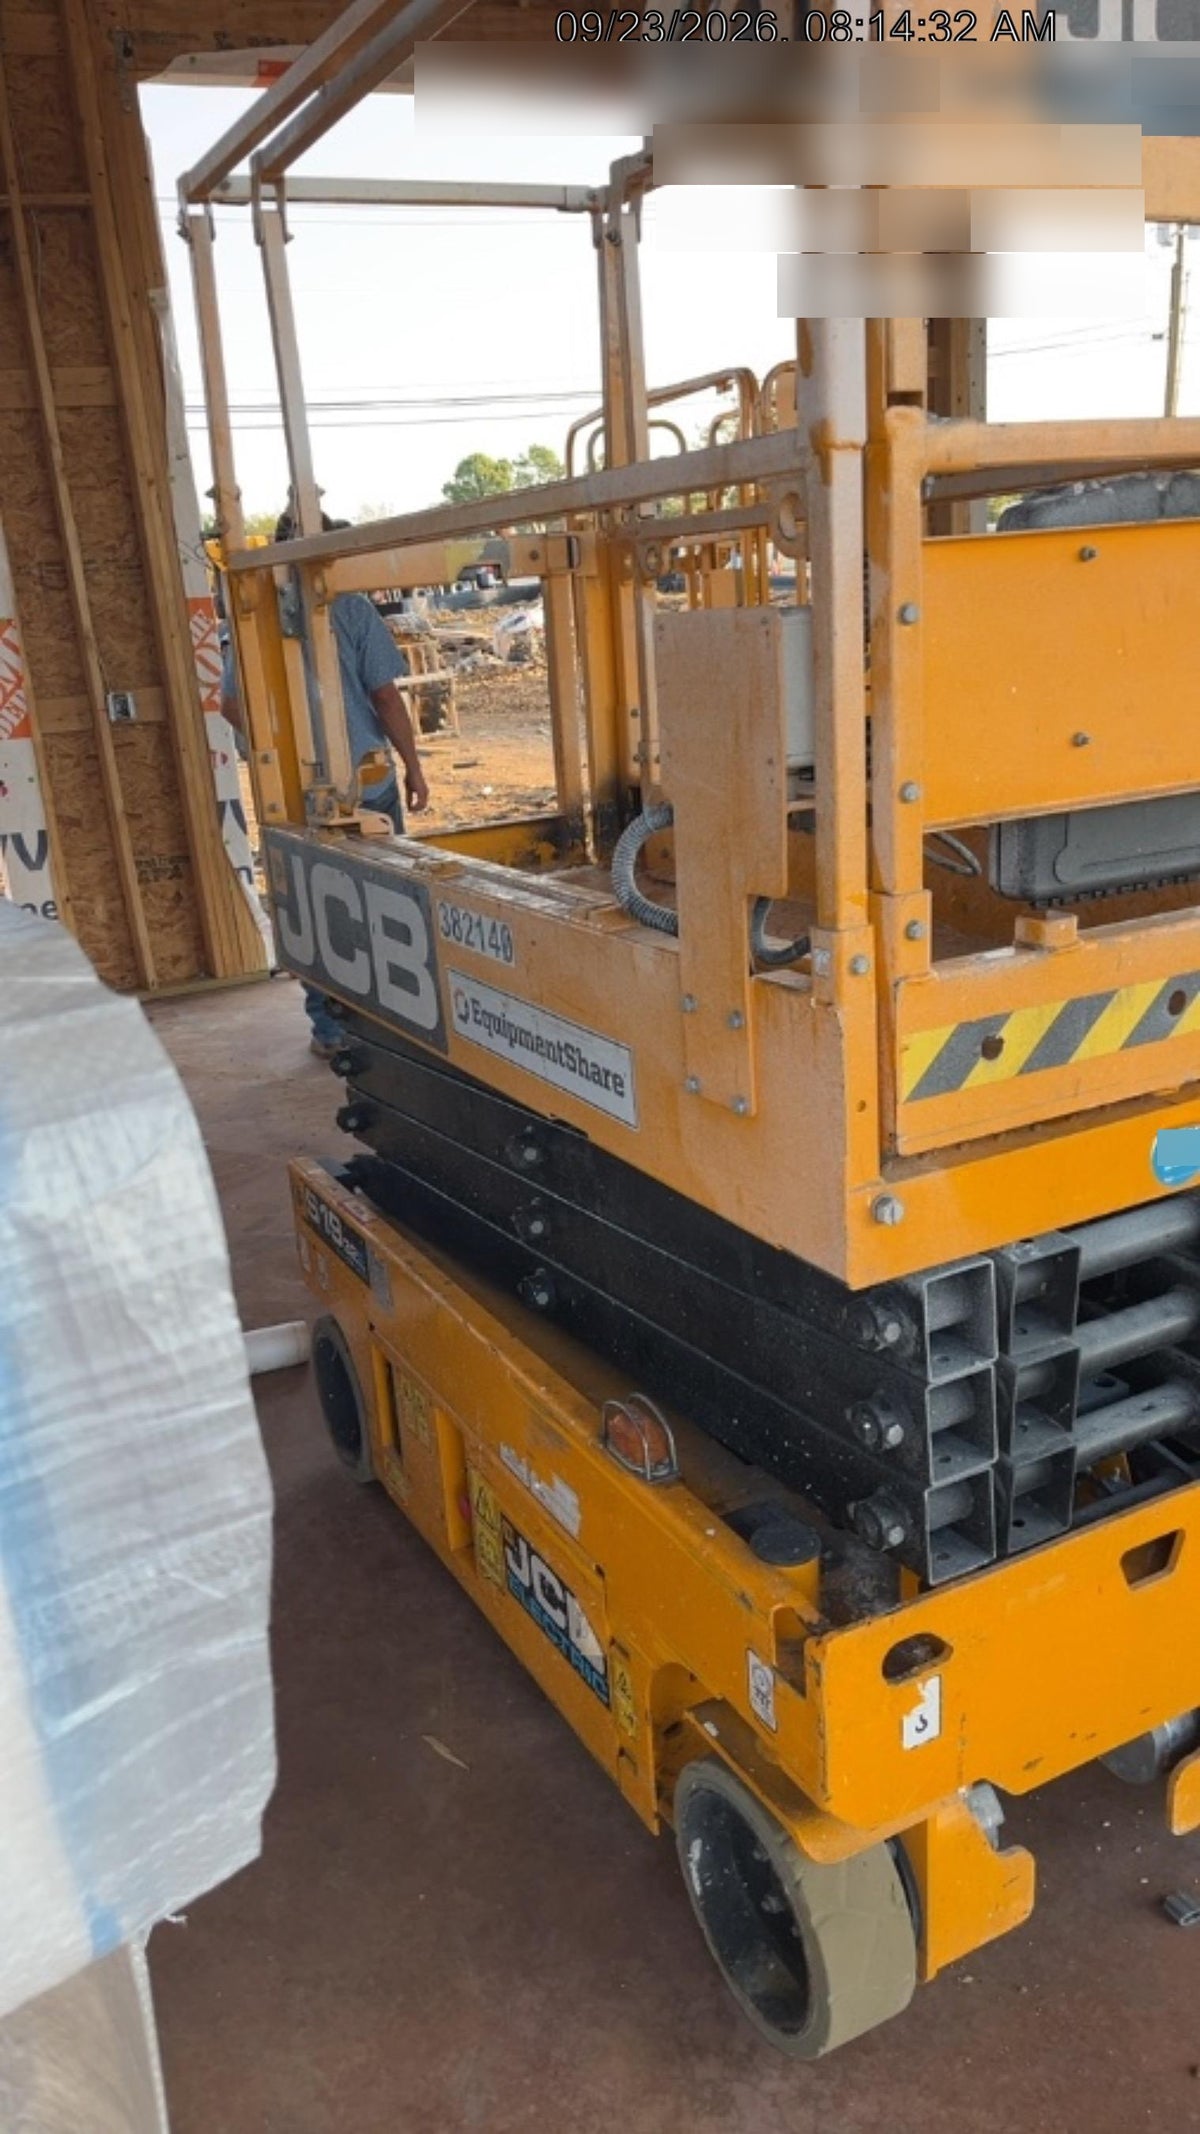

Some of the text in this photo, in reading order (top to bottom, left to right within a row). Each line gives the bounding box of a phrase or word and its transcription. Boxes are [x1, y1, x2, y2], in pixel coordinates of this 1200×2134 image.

[278, 856, 438, 1031] JCB
[439, 901, 514, 964] 382140
[471, 997, 625, 1098] EquipmentShare
